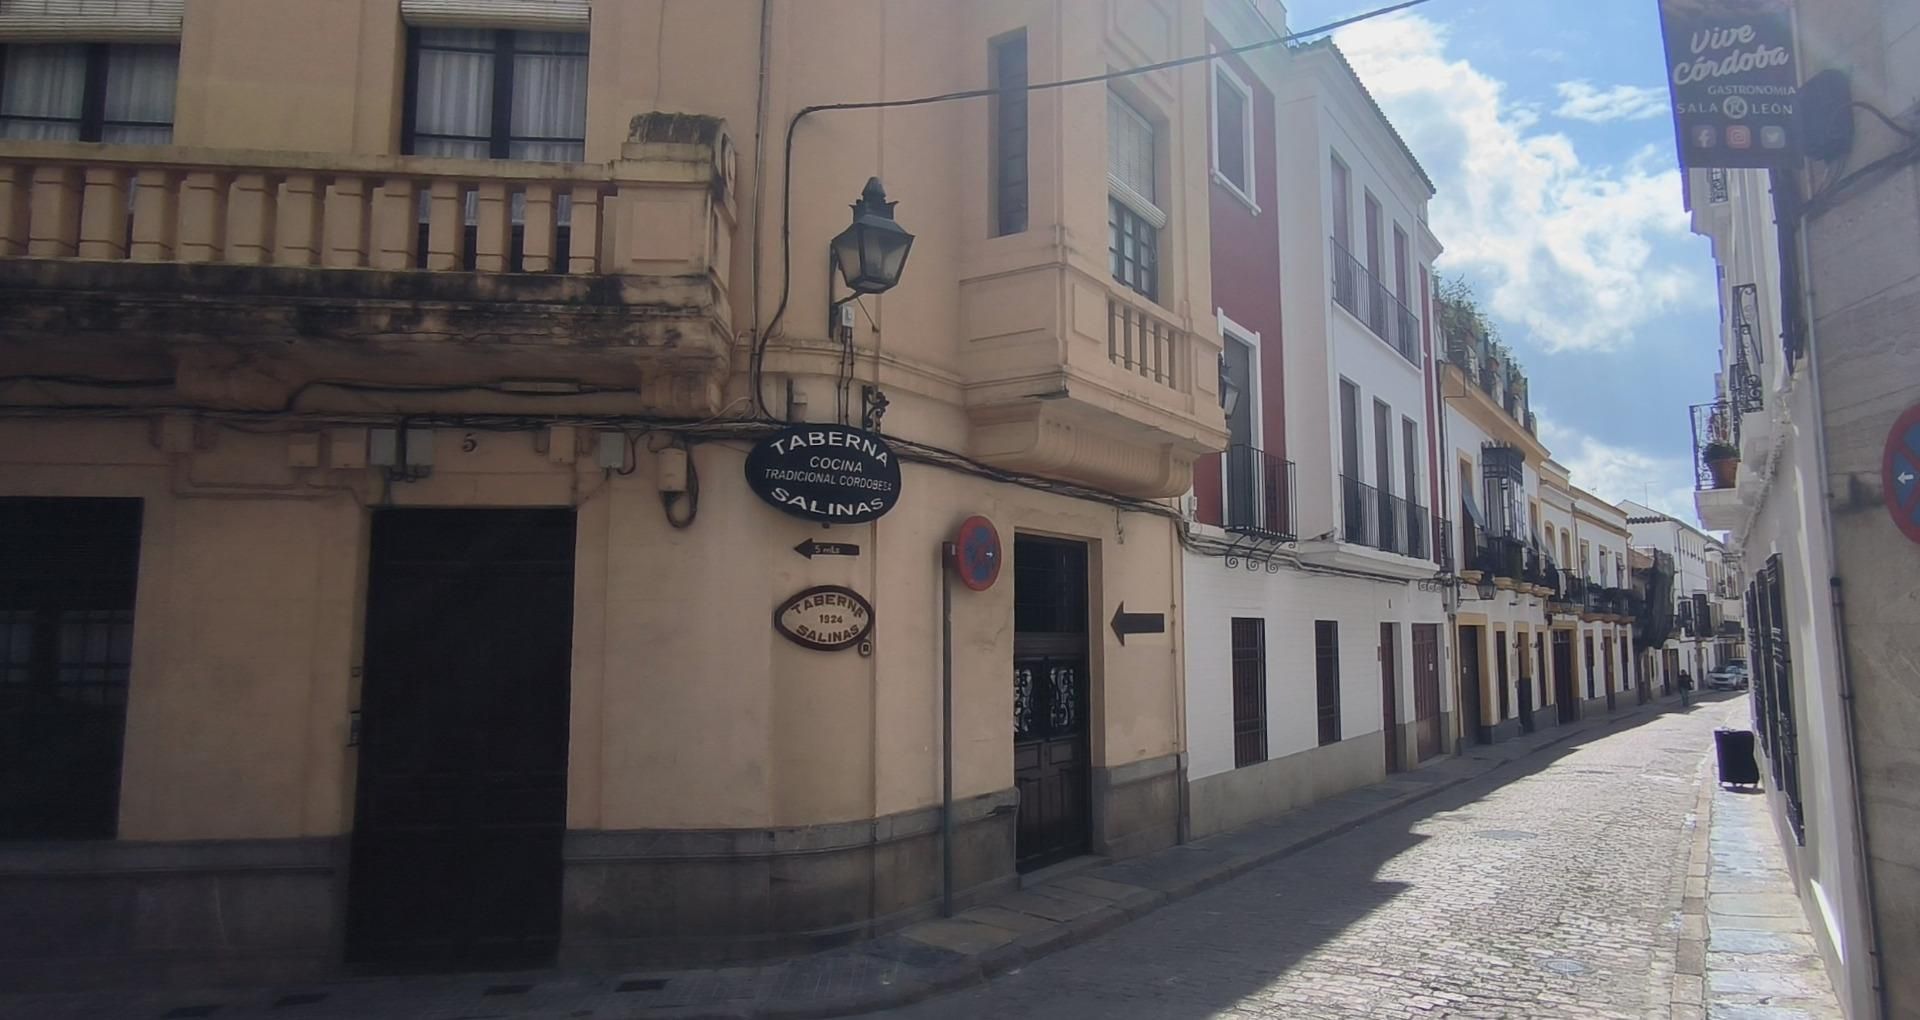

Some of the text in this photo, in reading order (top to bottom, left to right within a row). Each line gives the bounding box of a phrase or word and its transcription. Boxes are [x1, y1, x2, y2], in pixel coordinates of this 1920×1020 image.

[1691, 24, 1756, 54] Vive
[1673, 45, 1788, 85] Córdoba
[1677, 103, 1718, 114] SALA
[461, 432, 477, 453] 5
[770, 431, 888, 467] TABERNA
[809, 456, 863, 473] COCINA
[765, 468, 836, 485] TRADICIONAL
[771, 487, 884, 515] SALINAS
[791, 594, 865, 619] TABERNA
[819, 614, 843, 624] 1924
[796, 624, 860, 643] SALINAS
